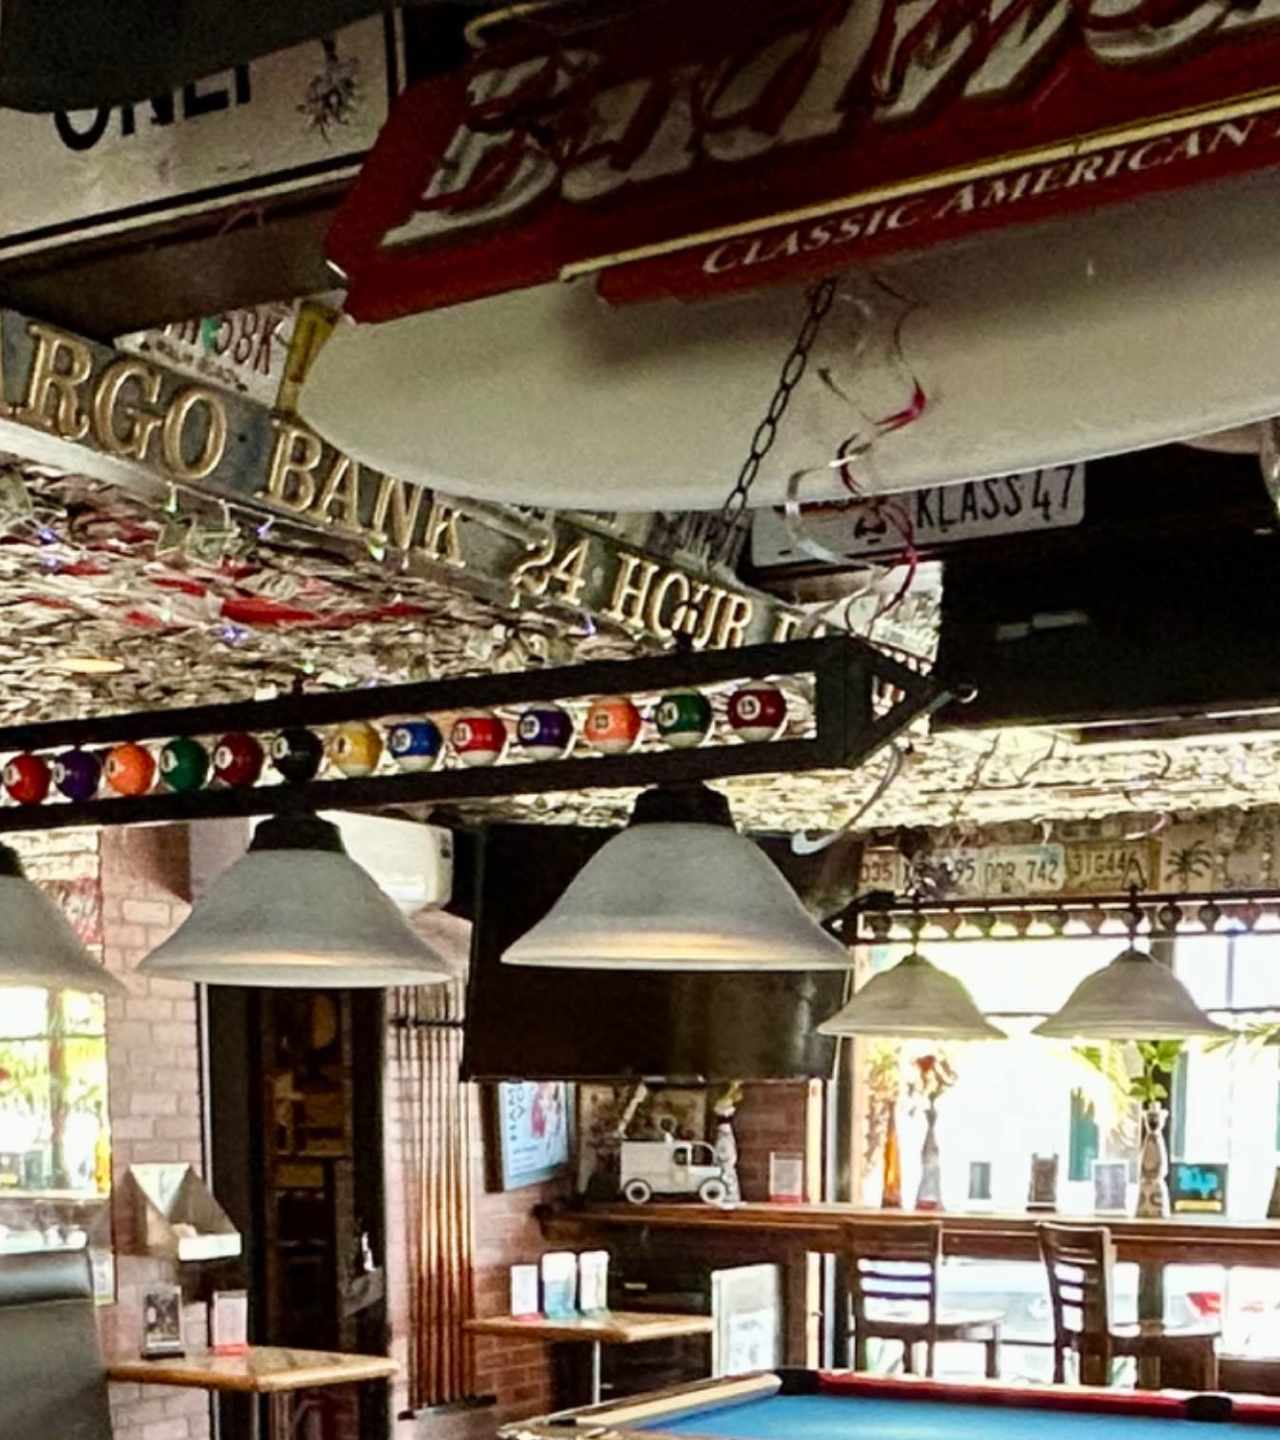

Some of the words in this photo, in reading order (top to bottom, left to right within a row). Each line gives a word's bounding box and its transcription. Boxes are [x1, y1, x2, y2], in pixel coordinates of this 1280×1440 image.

[703, 195, 924, 274] CLASSIC
[935, 116, 1258, 219] AMERICAN
[253, 418, 467, 568] BANK
[510, 513, 590, 609] 24
